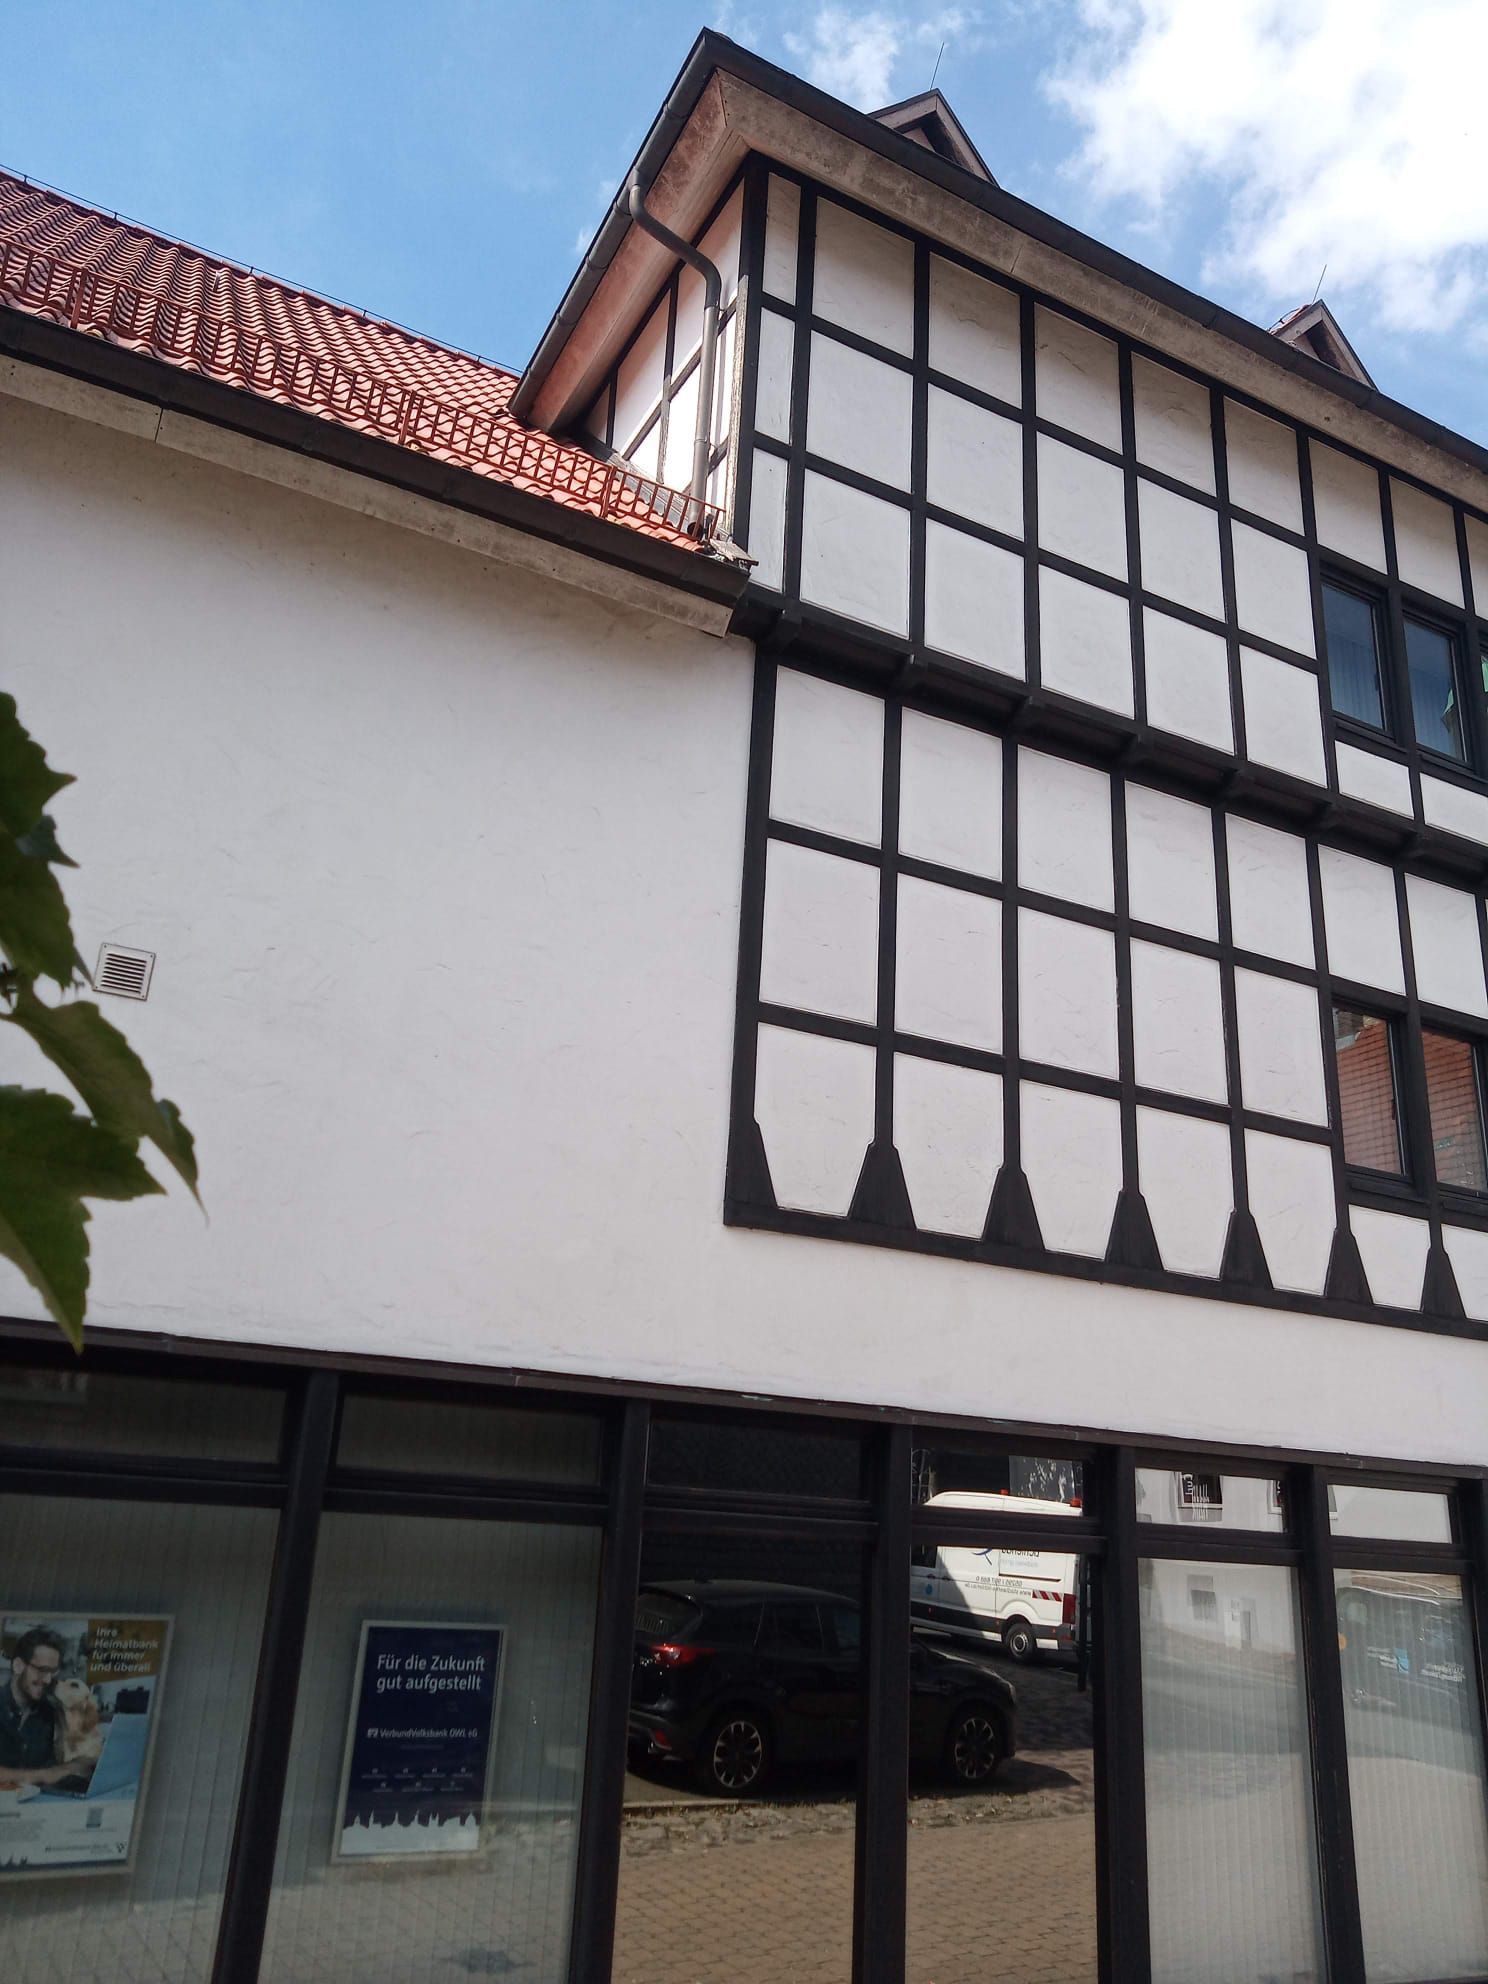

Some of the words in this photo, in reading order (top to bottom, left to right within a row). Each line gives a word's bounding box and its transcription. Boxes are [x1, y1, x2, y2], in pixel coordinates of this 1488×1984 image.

[96, 1626, 118, 1637] Ihre
[94, 1639, 159, 1649] Heimatbank
[92, 1650, 108, 1660] für
[110, 1650, 145, 1660] immer
[90, 1661, 112, 1672] und
[114, 1661, 151, 1673] überall
[377, 1654, 402, 1670] Für
[405, 1654, 427, 1670] die
[430, 1655, 485, 1671] Zukunft
[376, 1674, 402, 1694] gut
[405, 1673, 481, 1694] aufgestellt
